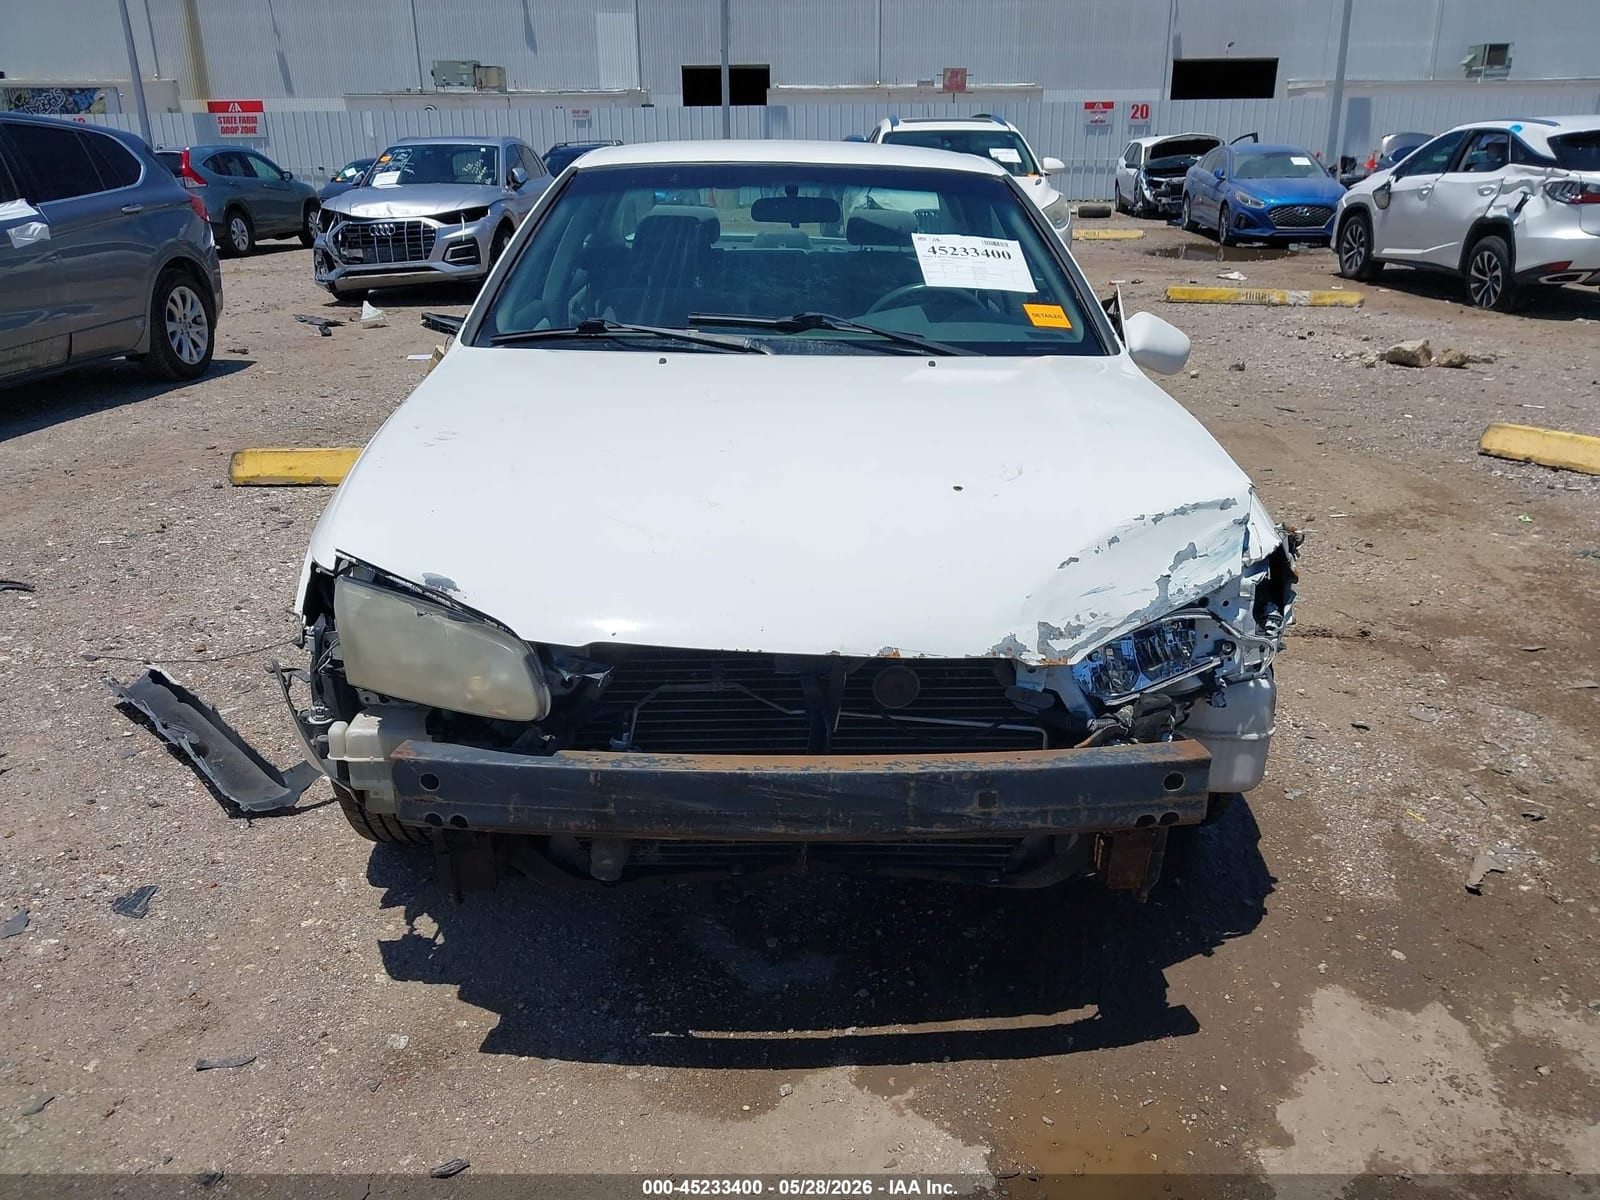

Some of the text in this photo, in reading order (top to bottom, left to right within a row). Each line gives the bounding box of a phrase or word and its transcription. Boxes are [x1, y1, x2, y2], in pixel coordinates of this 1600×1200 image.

[1131, 104, 1149, 119] 20
[217, 116, 258, 124] STATE FARM
[221, 126, 257, 134] DROP ZONE
[927, 245, 1012, 260] 45233400
